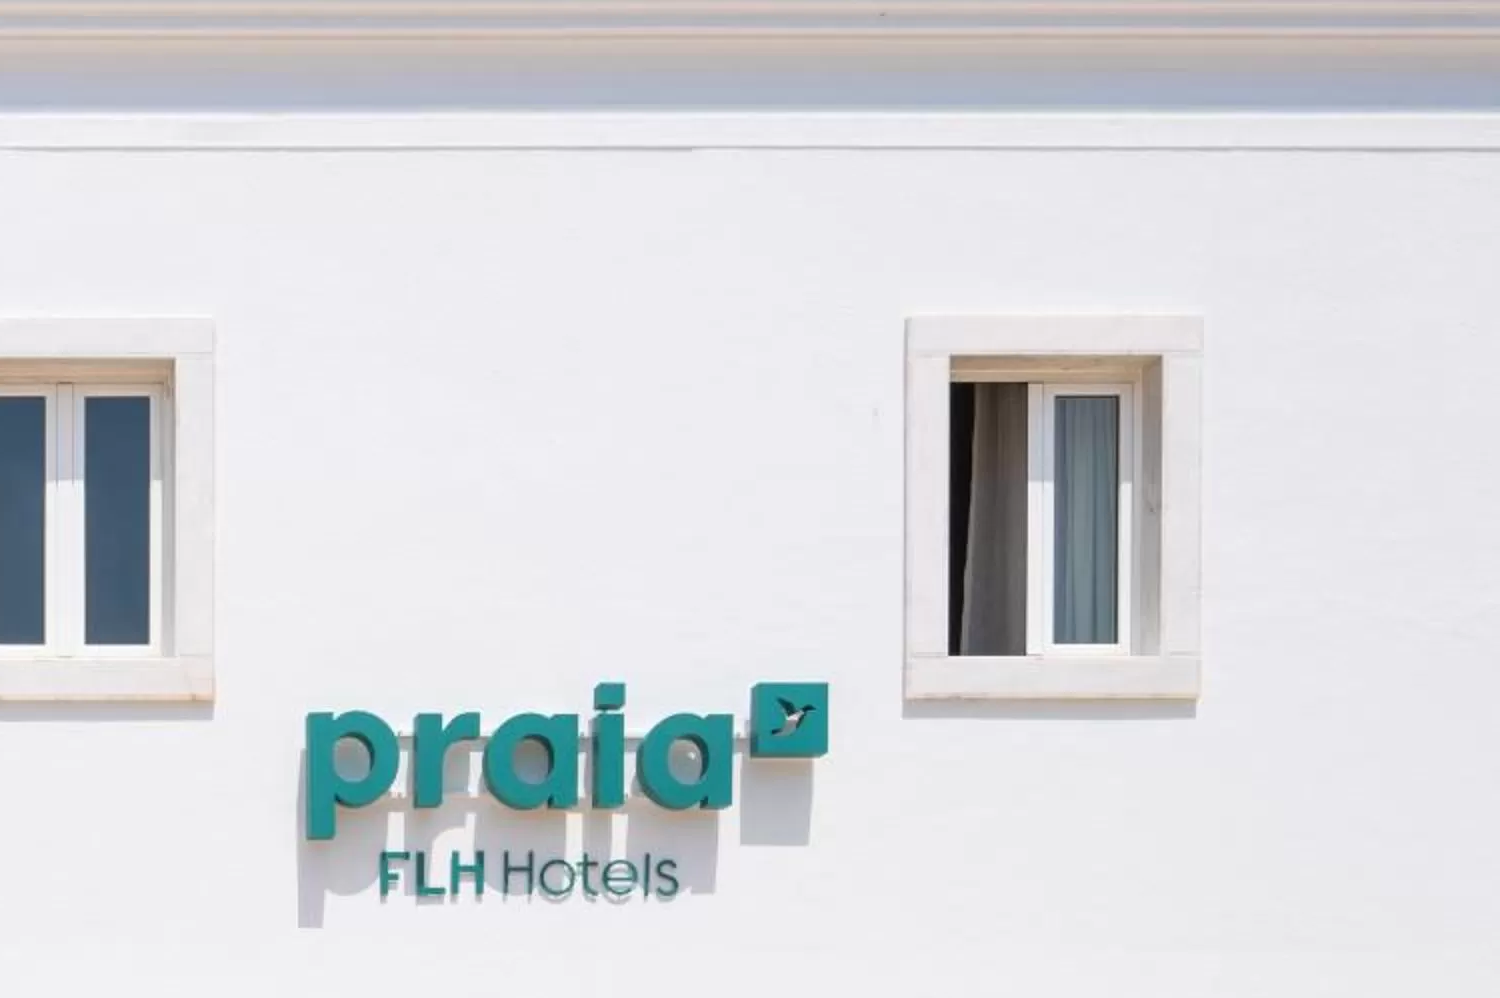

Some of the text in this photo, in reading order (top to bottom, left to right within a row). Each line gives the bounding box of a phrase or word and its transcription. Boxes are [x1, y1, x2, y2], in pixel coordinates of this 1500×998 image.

[305, 682, 734, 840] praia
[378, 850, 680, 897] FLH Hotels
